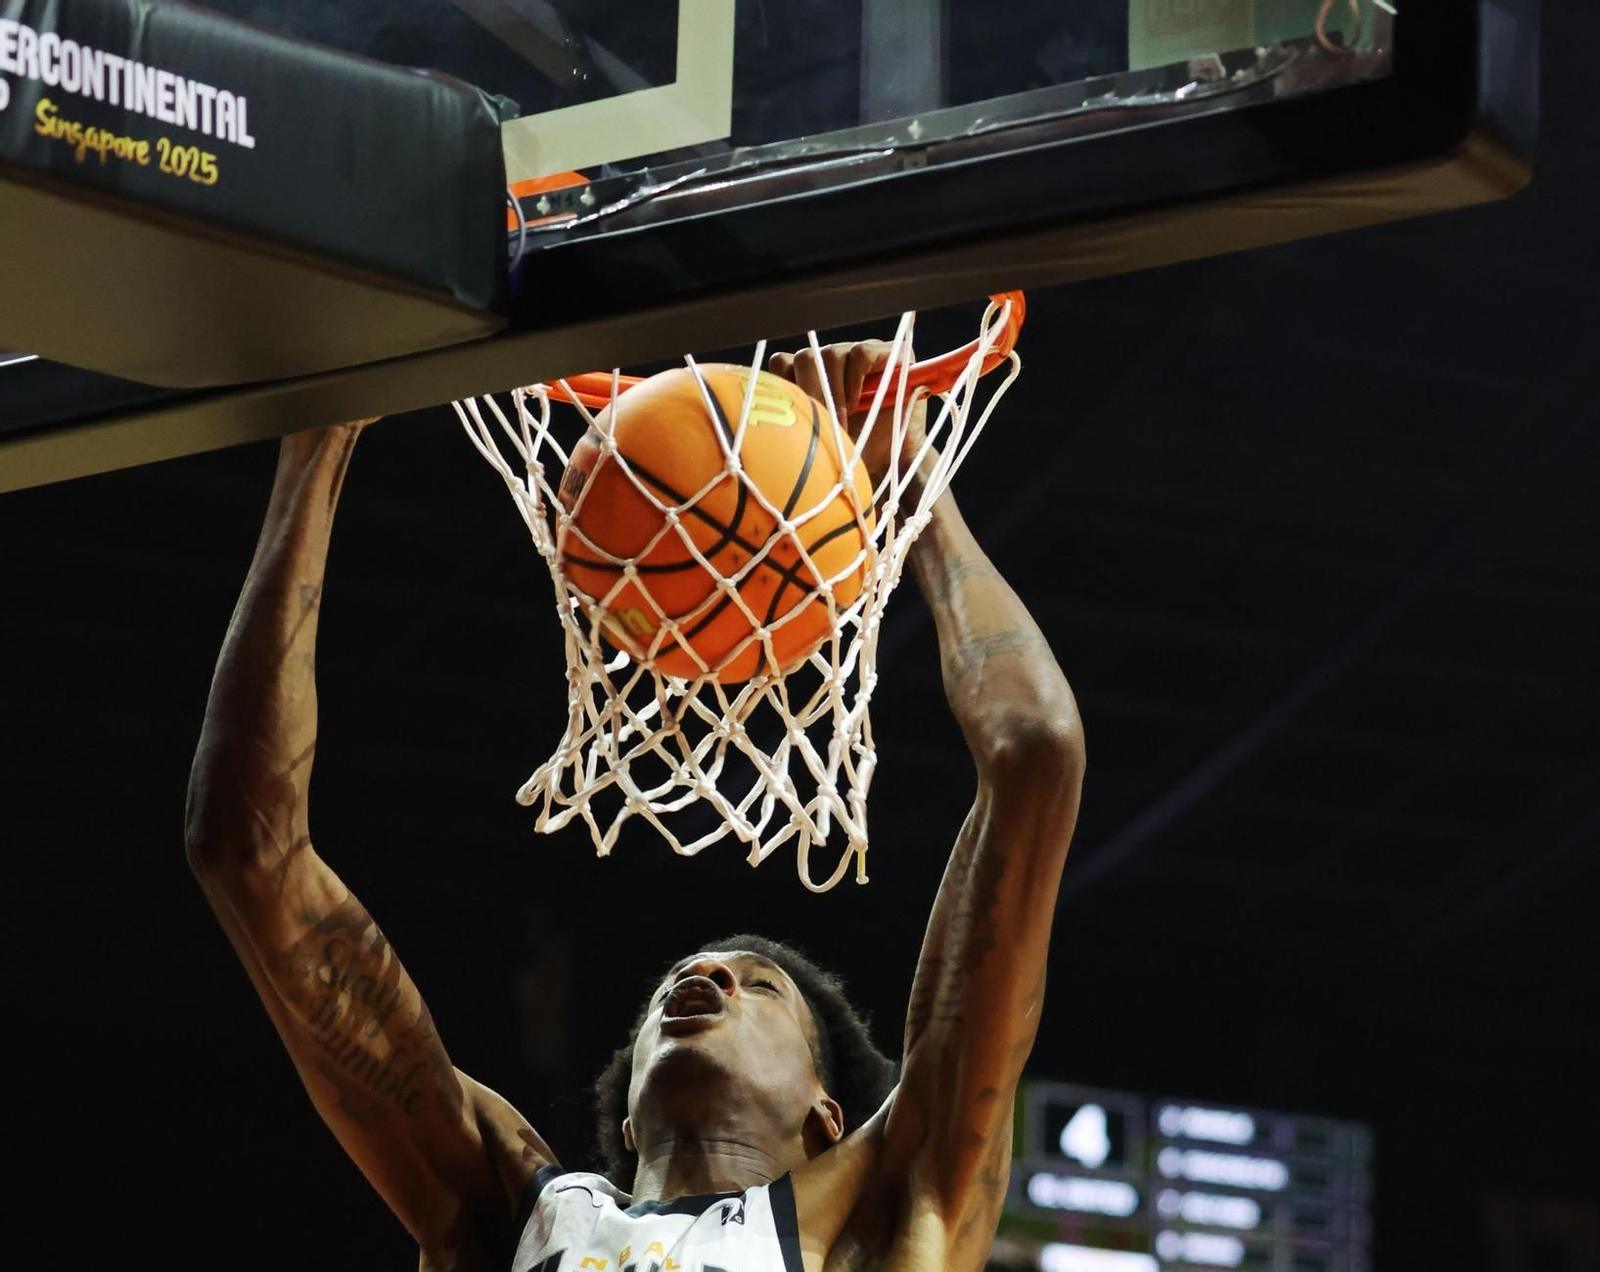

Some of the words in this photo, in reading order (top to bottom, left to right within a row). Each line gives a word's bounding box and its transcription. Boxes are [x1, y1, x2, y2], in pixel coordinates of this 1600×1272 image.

[0, 18, 256, 149] ERCONTINENTAL
[35, 98, 151, 165] Singapore
[156, 137, 219, 186] 2025
